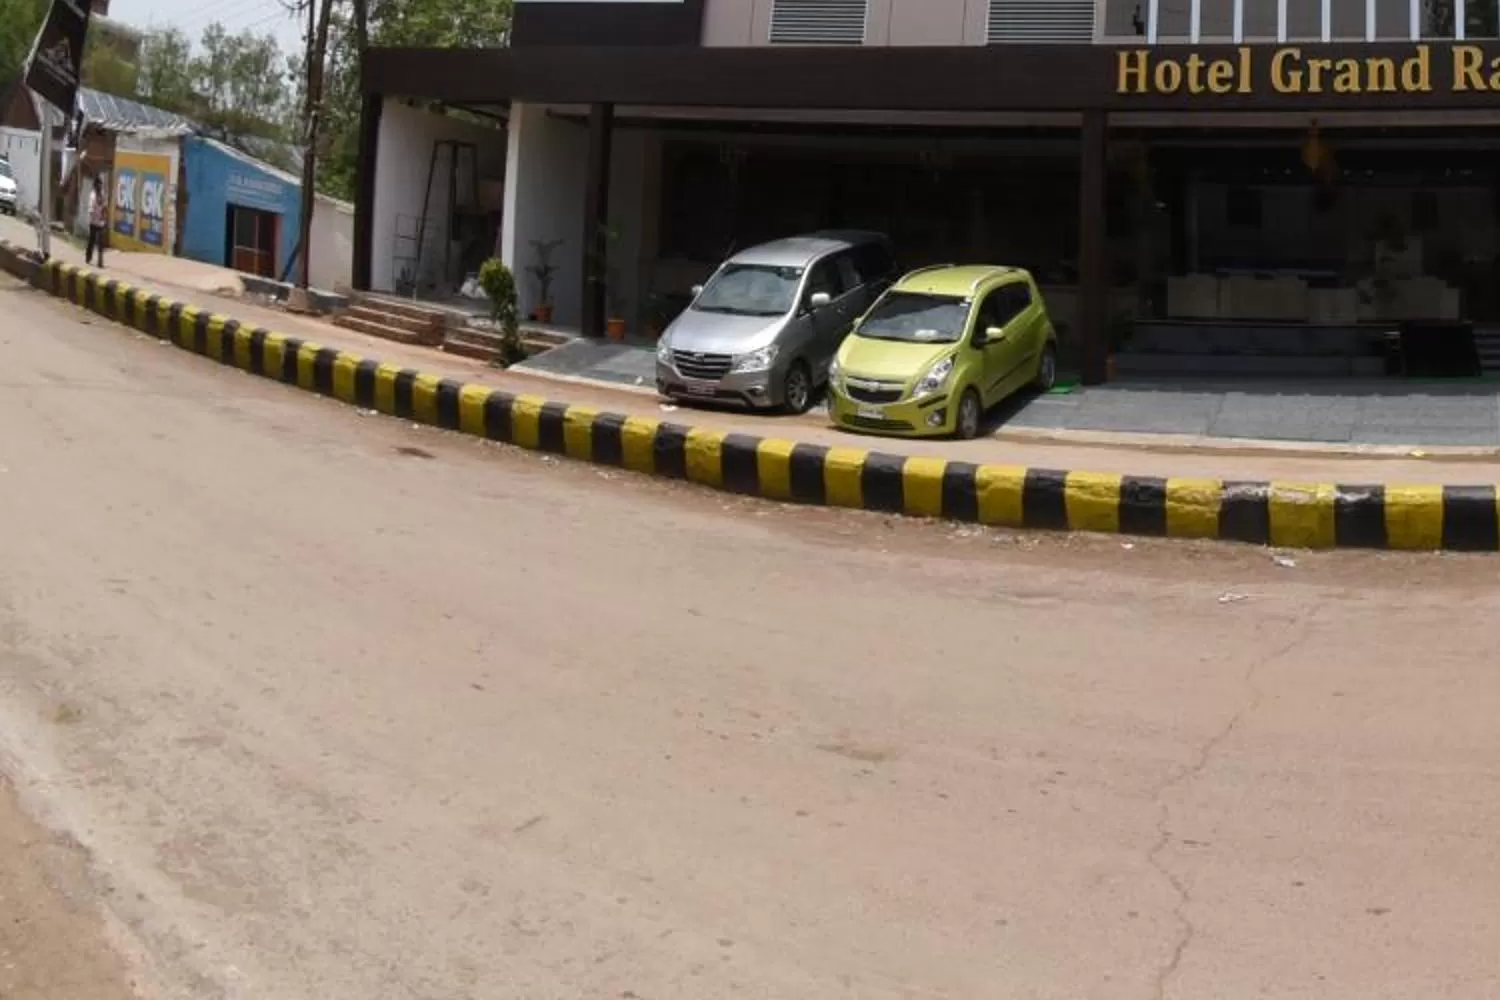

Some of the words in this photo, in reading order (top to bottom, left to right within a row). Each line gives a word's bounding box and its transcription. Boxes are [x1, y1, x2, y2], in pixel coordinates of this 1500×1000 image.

[1116, 47, 1252, 94] Hotel
[1271, 46, 1433, 94] Grand
[117, 175, 137, 210] GK
[142, 180, 164, 218] GK
